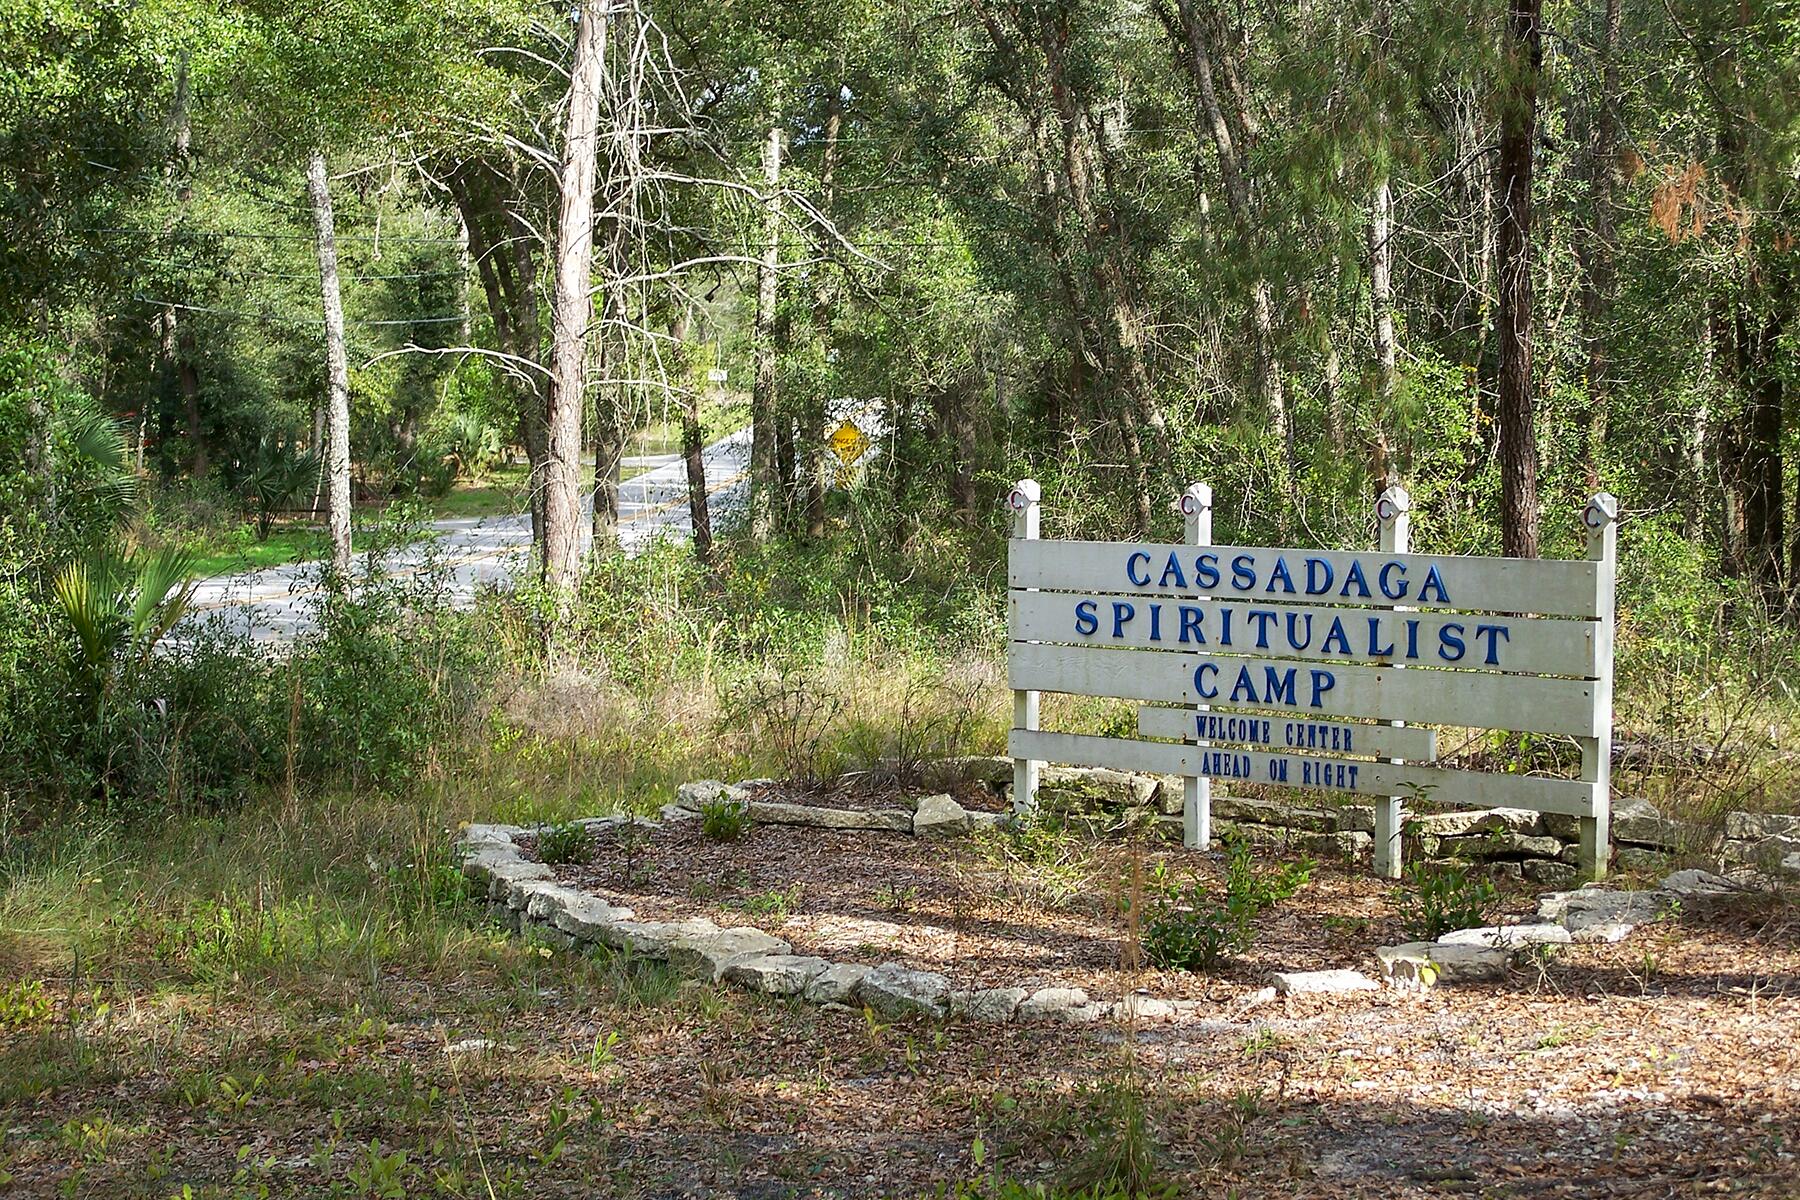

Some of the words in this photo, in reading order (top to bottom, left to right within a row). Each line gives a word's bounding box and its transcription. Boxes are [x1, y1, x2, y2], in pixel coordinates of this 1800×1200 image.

[1010, 491, 1024, 509] C
[1181, 495, 1196, 515] C
[1377, 499, 1393, 519] C
[1583, 506, 1601, 528] C
[1126, 550, 1451, 603] CASSADAGA
[1075, 599, 1509, 665] SPIRITUALIST
[1193, 662, 1336, 708] CAMP
[1196, 715, 1270, 744] WELCOME
[1286, 723, 1353, 751] CENTER
[1201, 752, 1250, 778] AHEAD
[1269, 759, 1288, 782] ON
[1303, 761, 1358, 789] RIGHT
